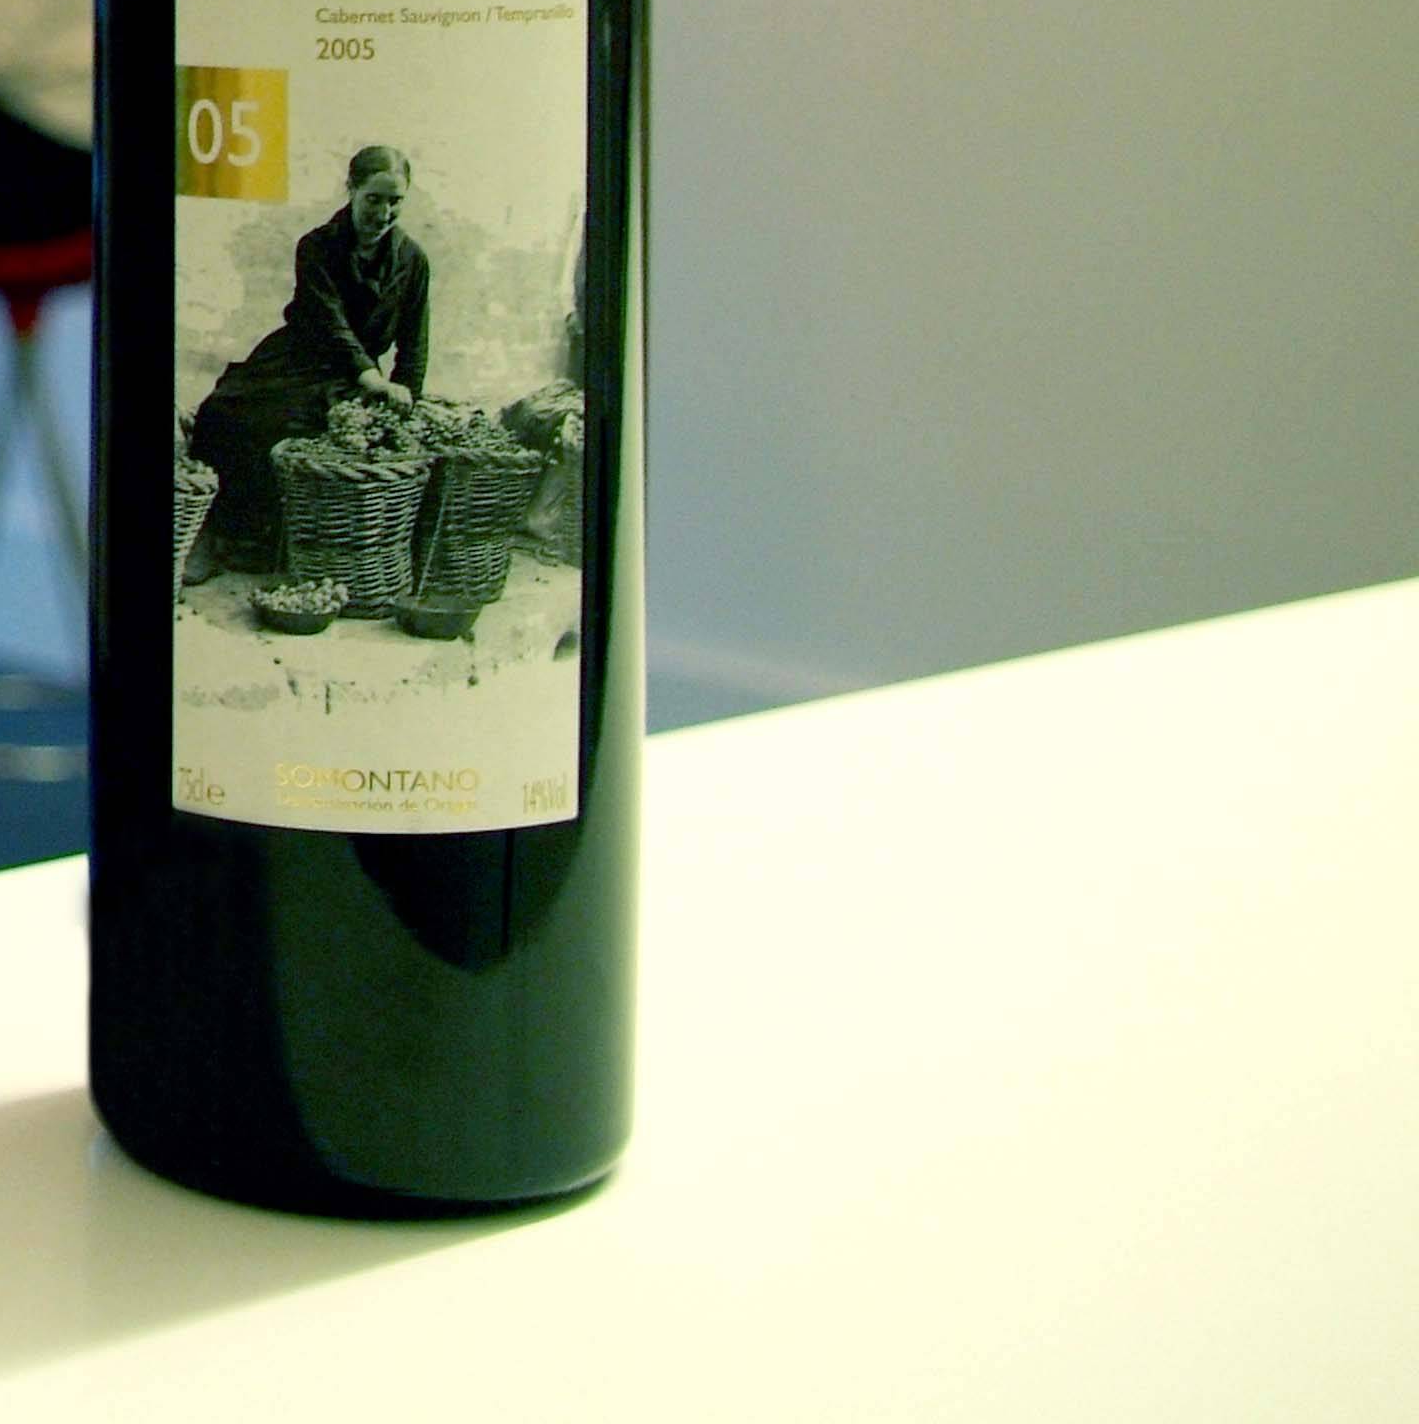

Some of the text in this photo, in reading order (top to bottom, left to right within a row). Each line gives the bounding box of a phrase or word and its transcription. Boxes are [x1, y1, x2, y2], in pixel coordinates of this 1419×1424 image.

[315, 8, 394, 24] Cabernet
[400, 8, 481, 26] Sauvignon
[316, 38, 375, 60] 2005
[188, 98, 262, 166] 05
[276, 762, 479, 793] SOMONTANO
